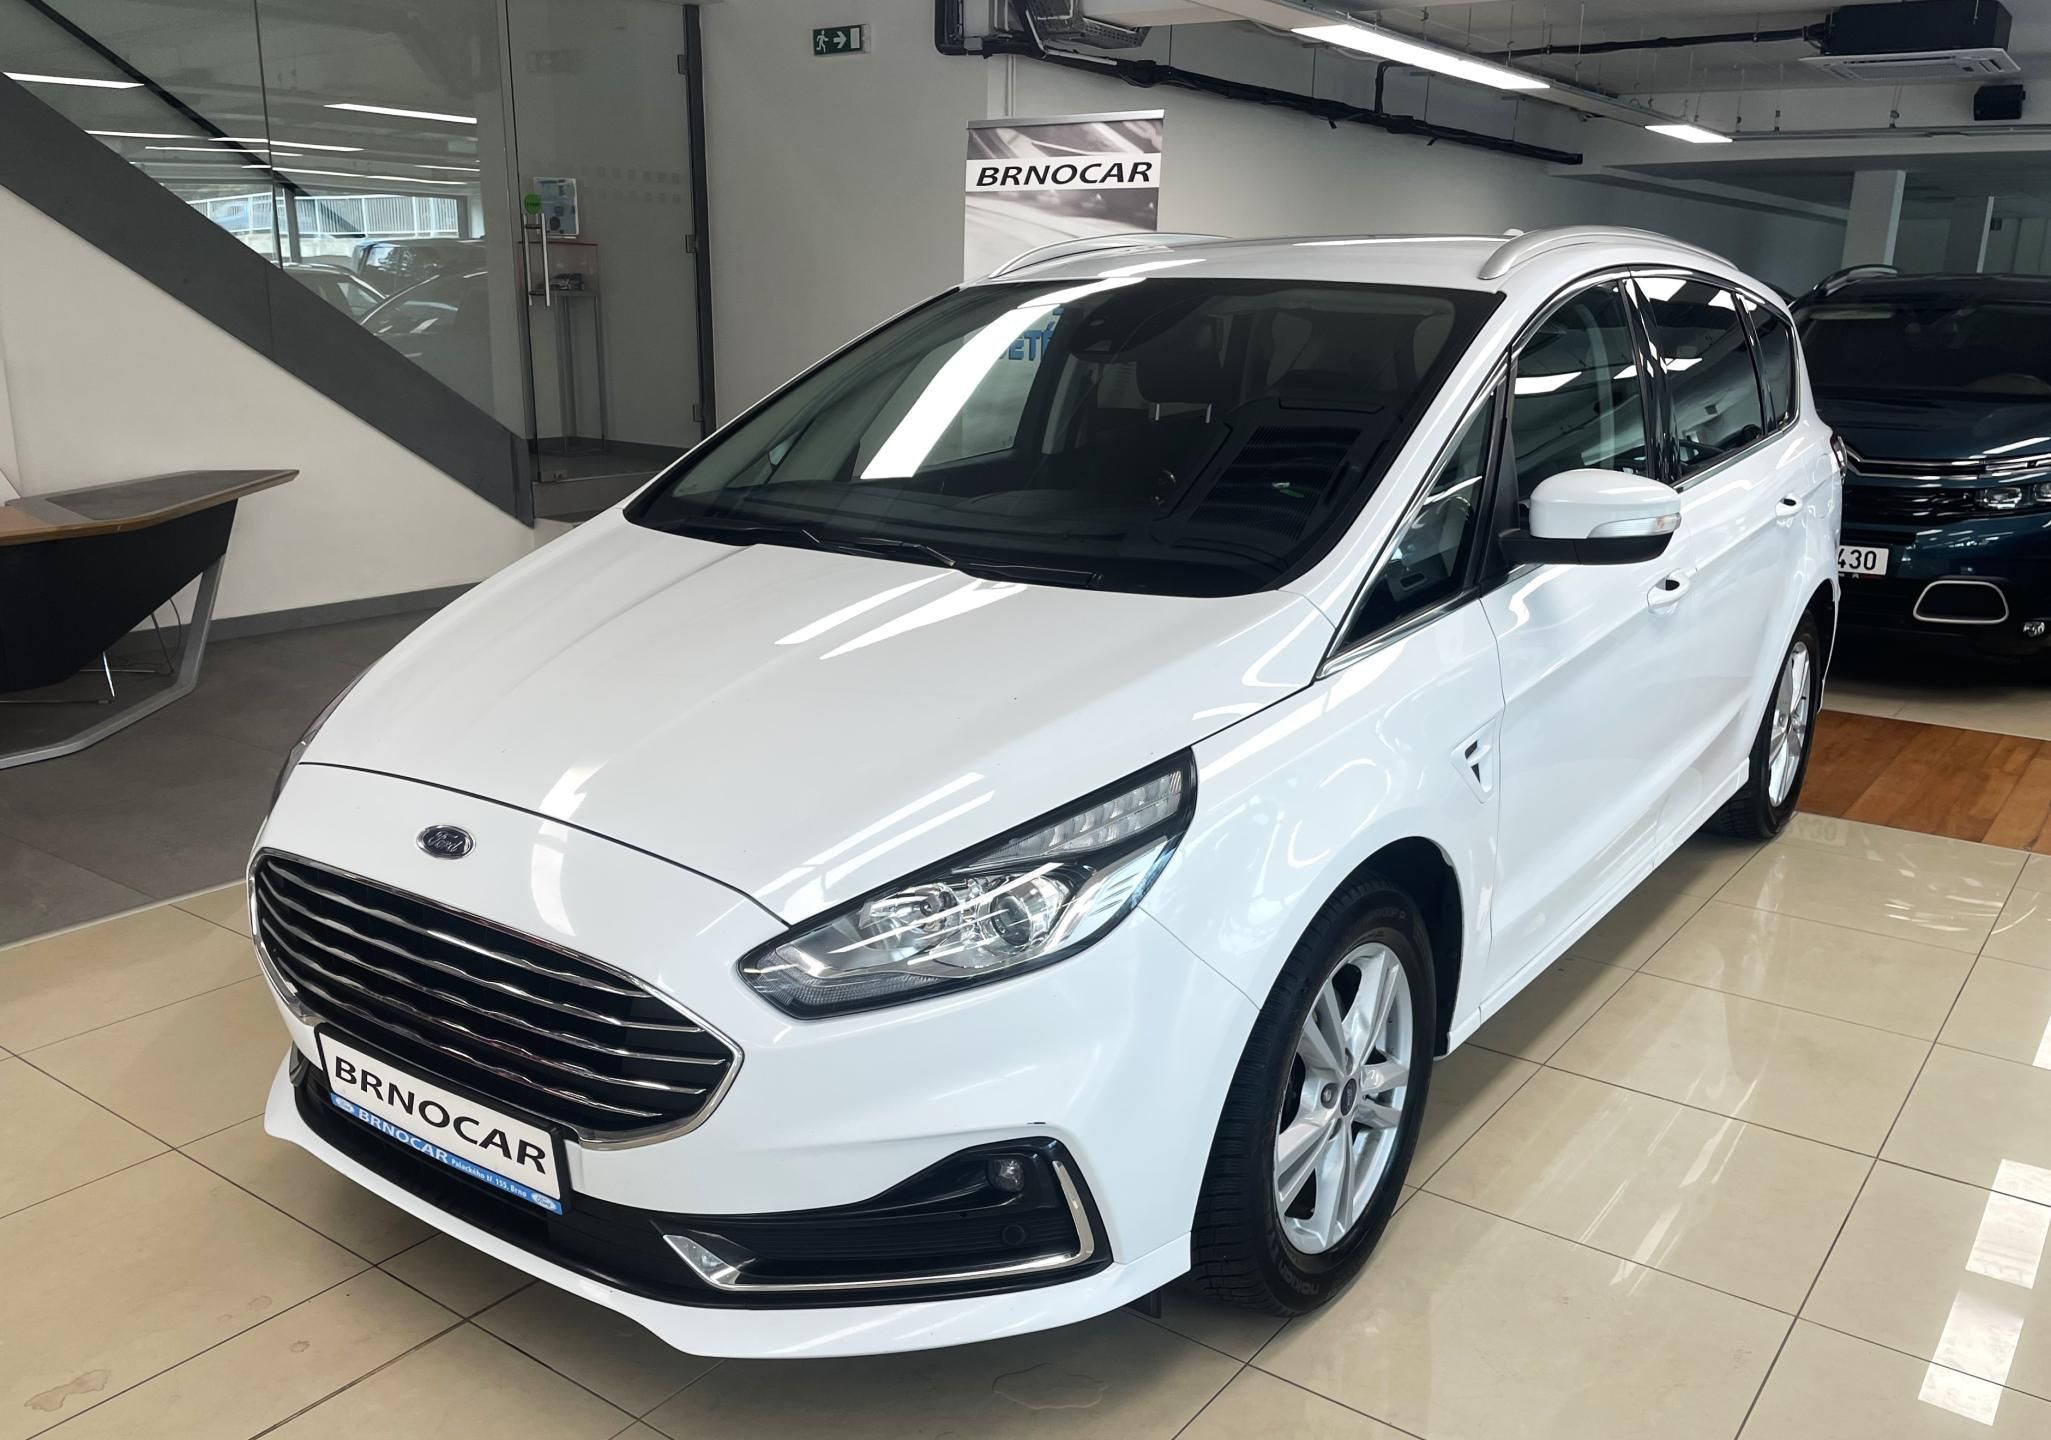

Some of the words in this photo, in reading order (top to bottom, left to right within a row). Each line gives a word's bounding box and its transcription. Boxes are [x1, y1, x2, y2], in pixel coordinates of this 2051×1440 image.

[976, 161, 1152, 187] BRNOCAR
[1838, 548, 1877, 571] 430
[334, 1056, 547, 1175] BRNOCAR
[358, 1108, 448, 1164] BRNOCAR
[450, 1158, 486, 1180] Palackého
[510, 1184, 527, 1198] Brno
